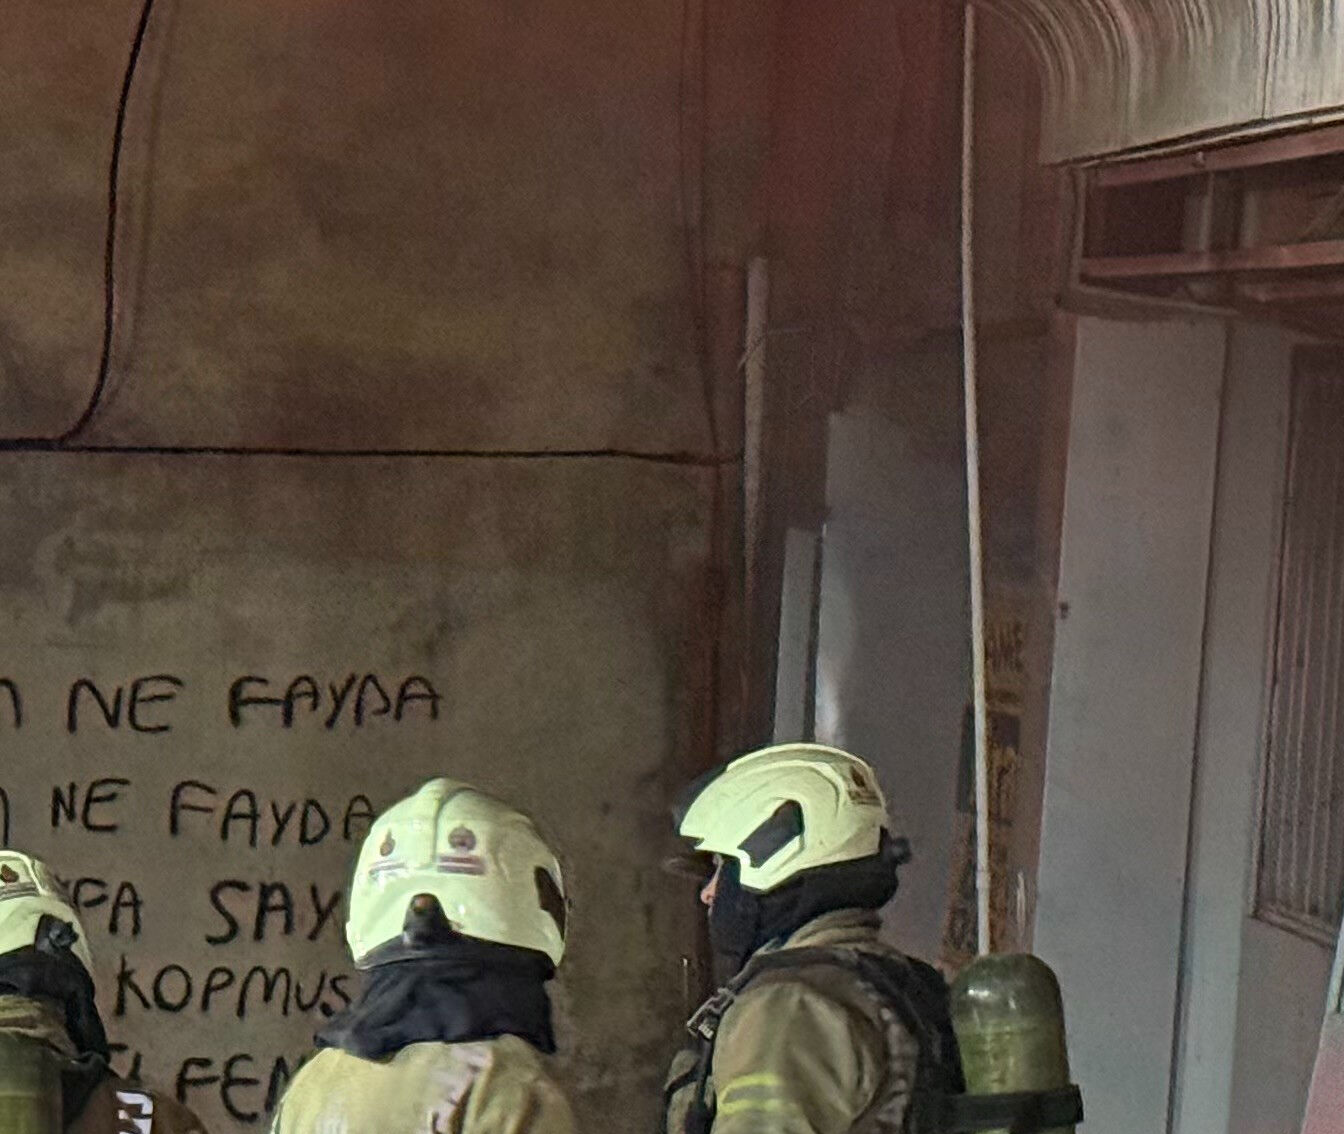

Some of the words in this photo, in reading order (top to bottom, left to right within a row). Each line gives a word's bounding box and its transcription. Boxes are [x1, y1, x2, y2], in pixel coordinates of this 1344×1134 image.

[67, 675, 184, 734] NE
[226, 674, 445, 730] FAYDA
[51, 777, 131, 834] NE
[168, 780, 374, 848] FAYDA
[55, 876, 143, 937] FA
[206, 878, 343, 945] SAY
